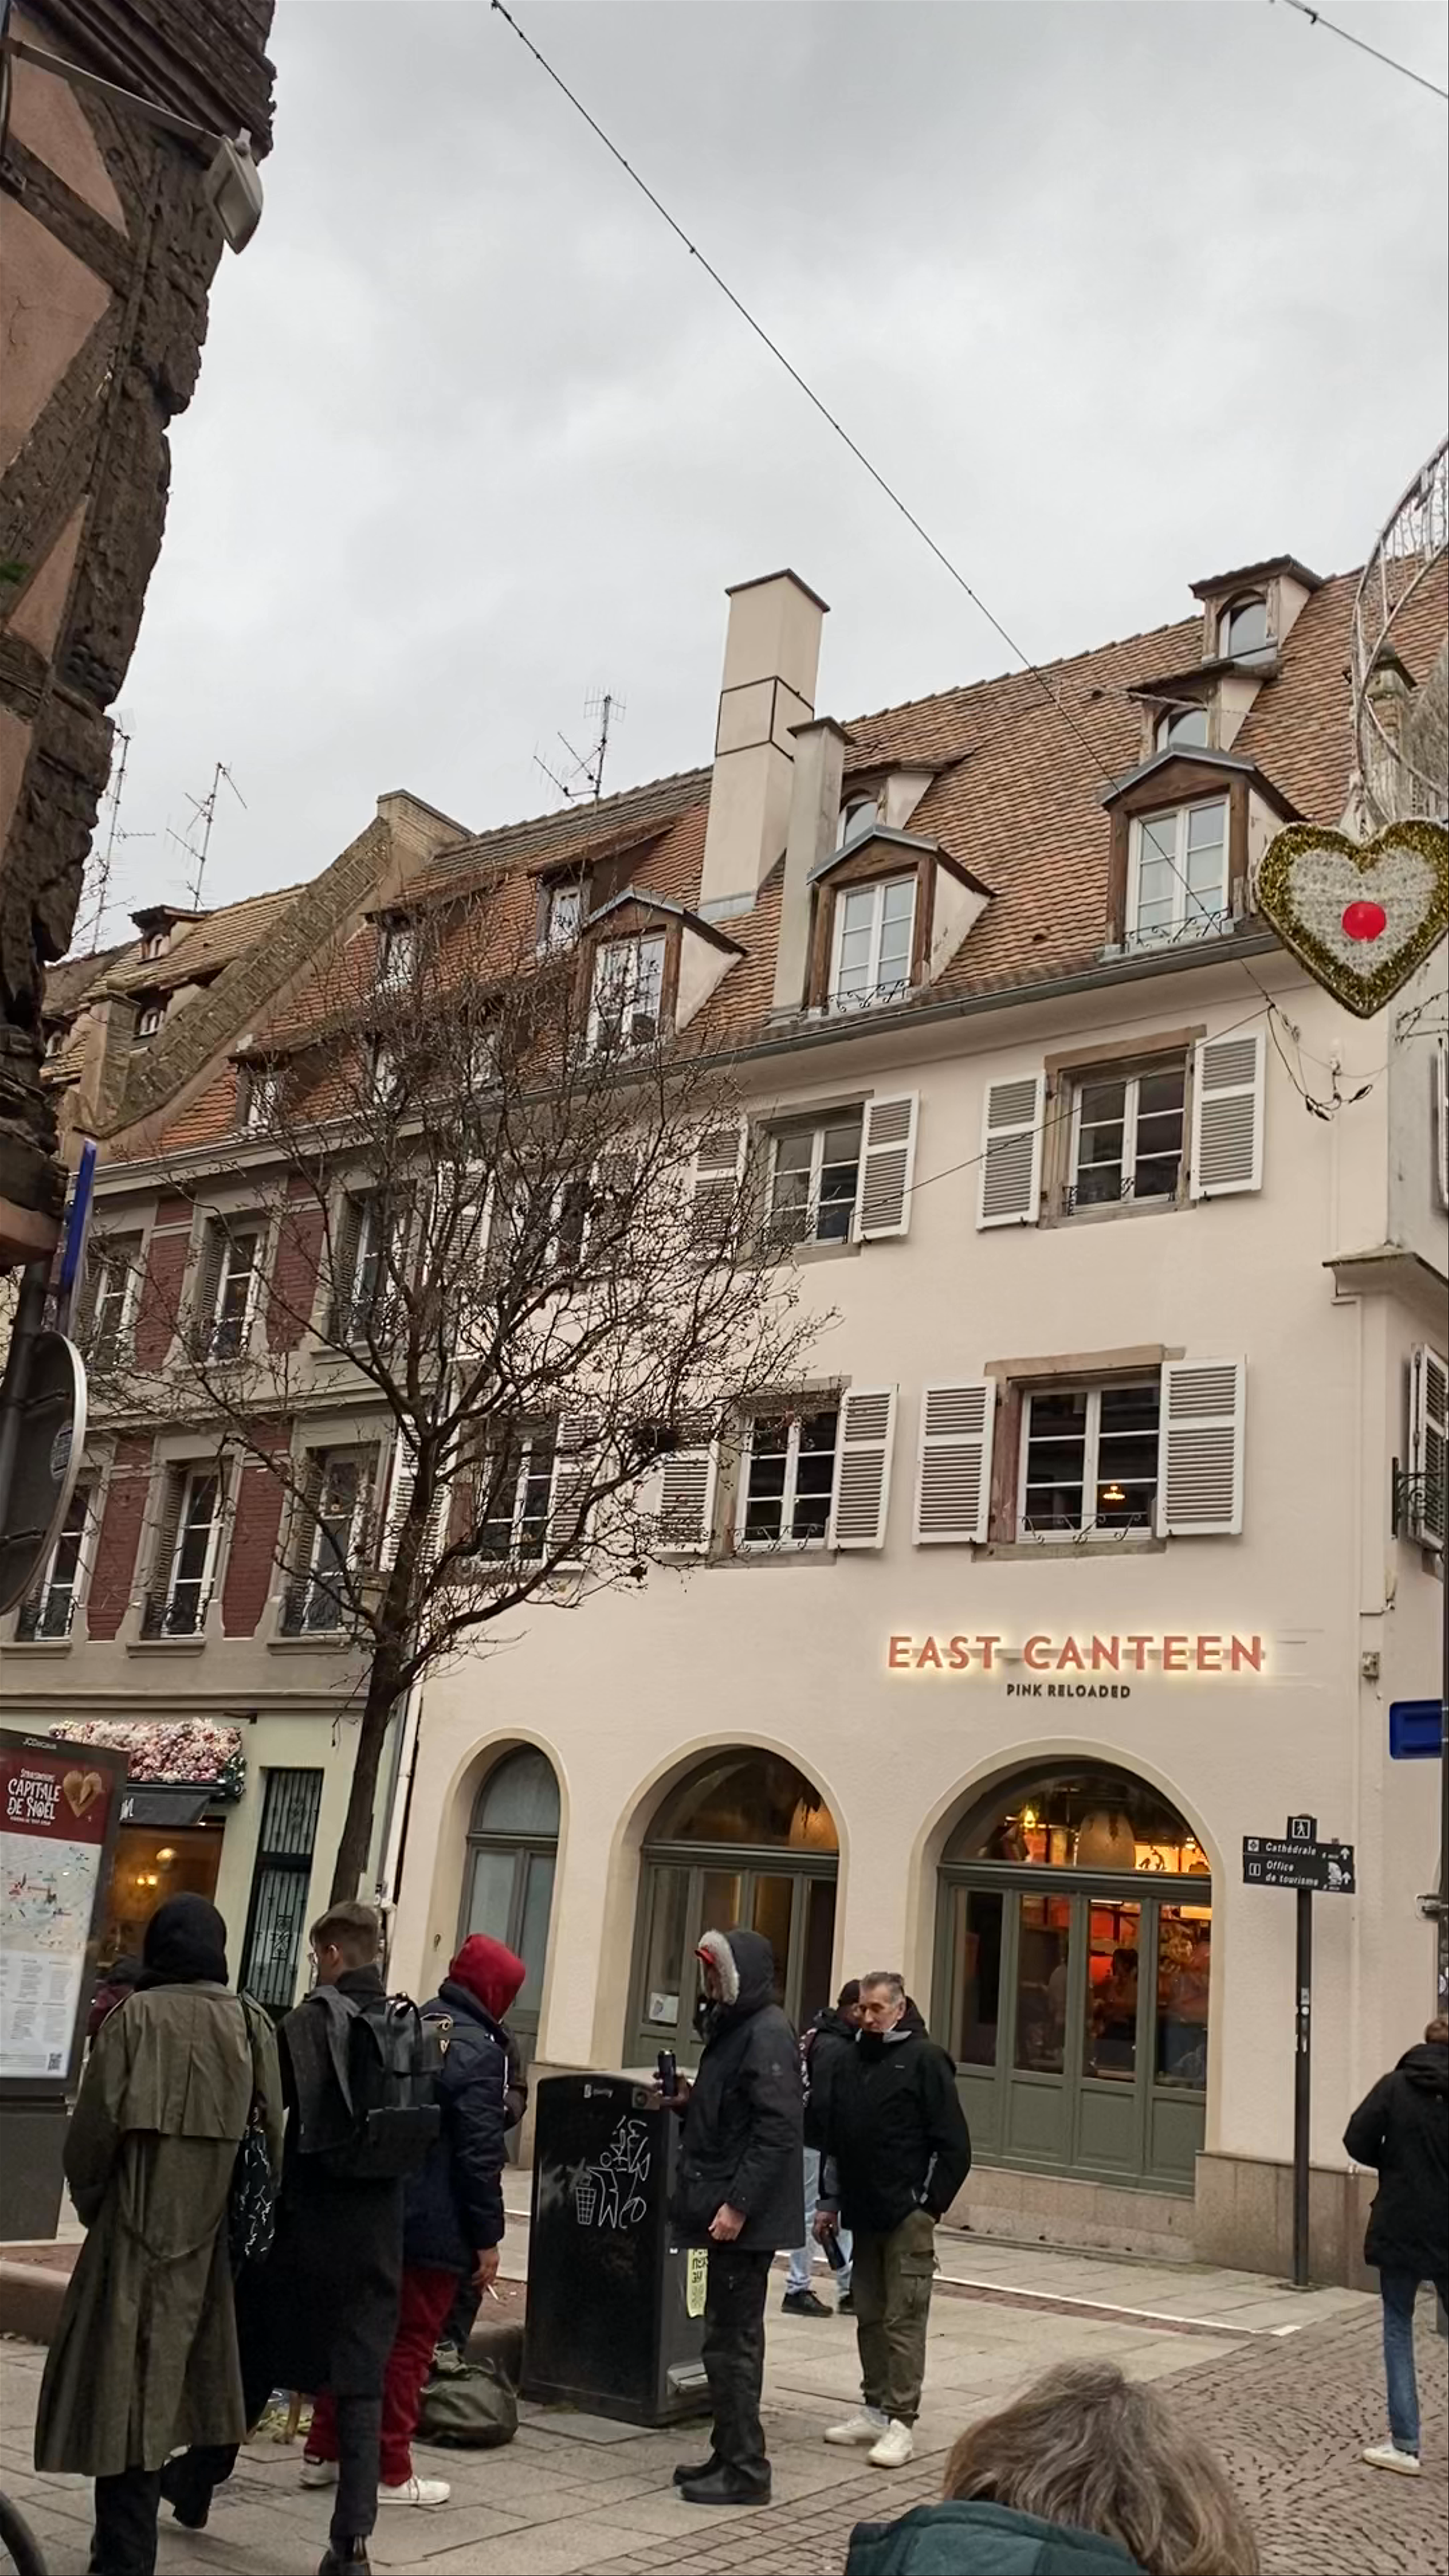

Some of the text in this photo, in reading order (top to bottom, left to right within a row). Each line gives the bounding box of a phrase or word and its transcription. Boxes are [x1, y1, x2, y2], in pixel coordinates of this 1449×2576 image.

[888, 1635, 1261, 1671] EAST CANTEEN
[1007, 1684, 1131, 1698] PINK RELOADED
[8, 1778, 62, 1802] CAPITALE
[7, 1797, 24, 1815] DE
[1266, 1842, 1316, 1856] Cathédrale
[1266, 1860, 1294, 1872] Office
[1266, 1873, 1319, 1886] de tourisme
